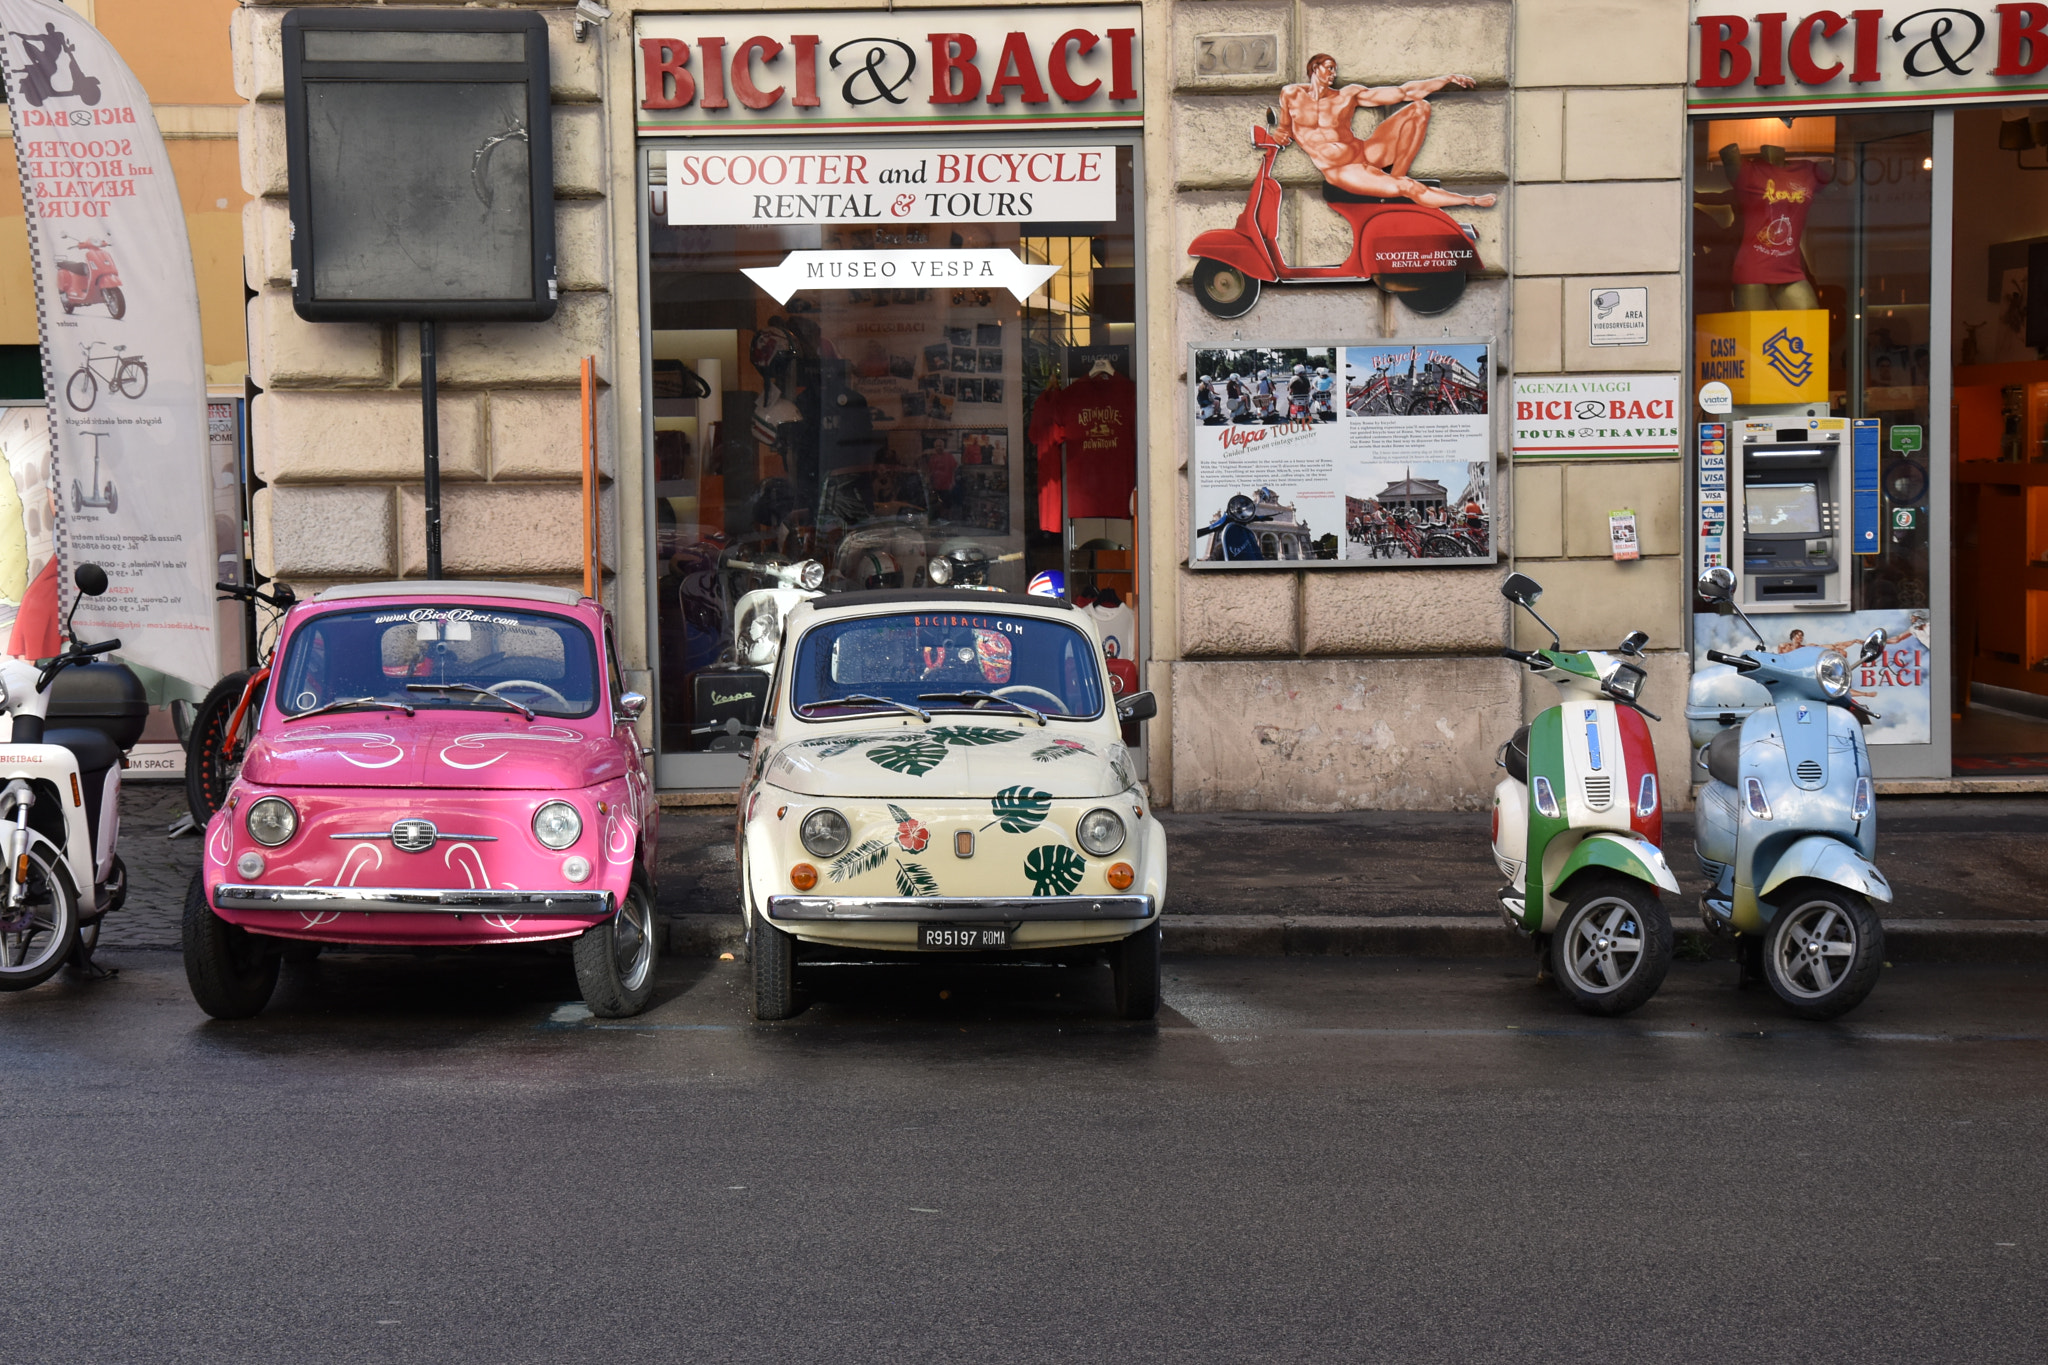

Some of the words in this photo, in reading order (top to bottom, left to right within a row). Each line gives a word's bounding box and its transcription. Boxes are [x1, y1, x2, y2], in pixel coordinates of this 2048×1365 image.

[1198, 38, 1273, 71] 302
[1695, 9, 1884, 88] BICI
[1892, 8, 1985, 77] &
[639, 34, 820, 110] BICI
[829, 37, 917, 105] &
[927, 28, 1137, 104] BACI
[681, 154, 868, 186] SCOOTER
[878, 159, 927, 185] and
[936, 152, 1102, 184] BICYCLE
[753, 193, 882, 219] RENTAL
[890, 193, 914, 217] &
[925, 192, 1034, 217] TOURS
[1375, 251, 1419, 261] SCOOTER
[1434, 250, 1473, 259] BICYCLE
[1392, 260, 1422, 268] RENTAL
[1431, 259, 1457, 267] TOURS
[807, 261, 897, 279] MUSEO
[911, 260, 995, 278] VESPA
[1625, 311, 1643, 319] AREA
[1593, 321, 1645, 330] VIDEOSORVEGLIATA
[1710, 338, 1736, 358] CASH
[1371, 349, 1422, 369] Bicycle
[1426, 349, 1459, 366] Tour
[1701, 359, 1745, 381] MACHINE
[1517, 382, 1578, 394] AGENZIA
[1581, 381, 1631, 393] VIAGGI
[1516, 400, 1573, 421] BICI
[1609, 399, 1674, 420] BACI
[1218, 425, 1268, 450] Vespa
[1270, 415, 1314, 438] TOUR
[1517, 429, 1576, 439] TOURS
[1596, 427, 1678, 438] TRAVELS
[1246, 445, 1261, 453] Tour
[1271, 438, 1294, 448] vintage
[1294, 432, 1318, 442] scooter
[1703, 457, 1724, 466] VISA
[1703, 473, 1724, 482] VISA
[1708, 511, 1724, 519] PLUS
[375, 608, 519, 627] www.BiciBaci.com
[914, 616, 1023, 635] BICIBACI.COM
[1860, 668, 1922, 687] BACI
[711, 690, 756, 706] Vespa
[144, 759, 175, 768] SPACE
[926, 930, 977, 946] R95197
[982, 930, 1005, 945] ROMA
